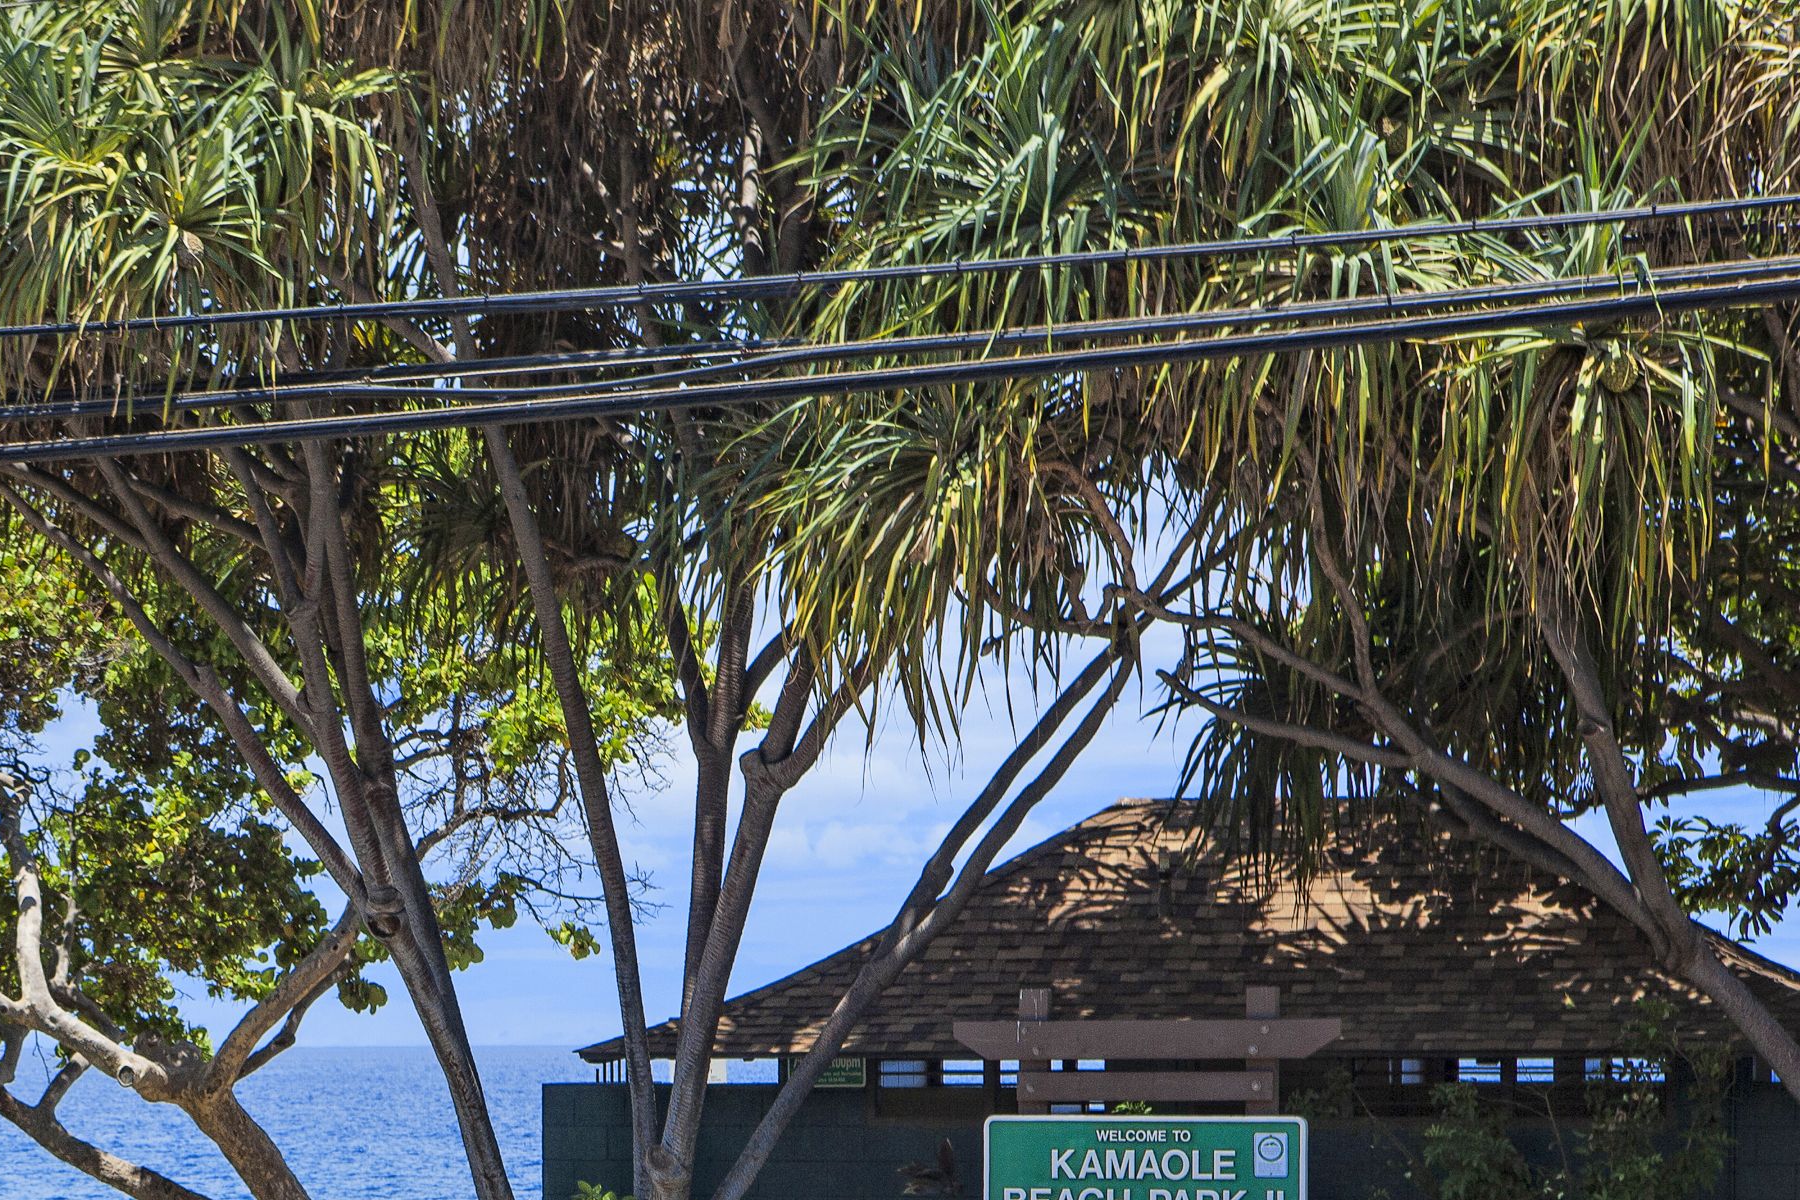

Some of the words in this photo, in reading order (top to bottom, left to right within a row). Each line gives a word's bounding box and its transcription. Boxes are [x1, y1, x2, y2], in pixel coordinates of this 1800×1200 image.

[1095, 1129, 1167, 1142] WELCOME
[1172, 1129, 1191, 1142] TO
[1051, 1148, 1236, 1181] KAMAOLE
